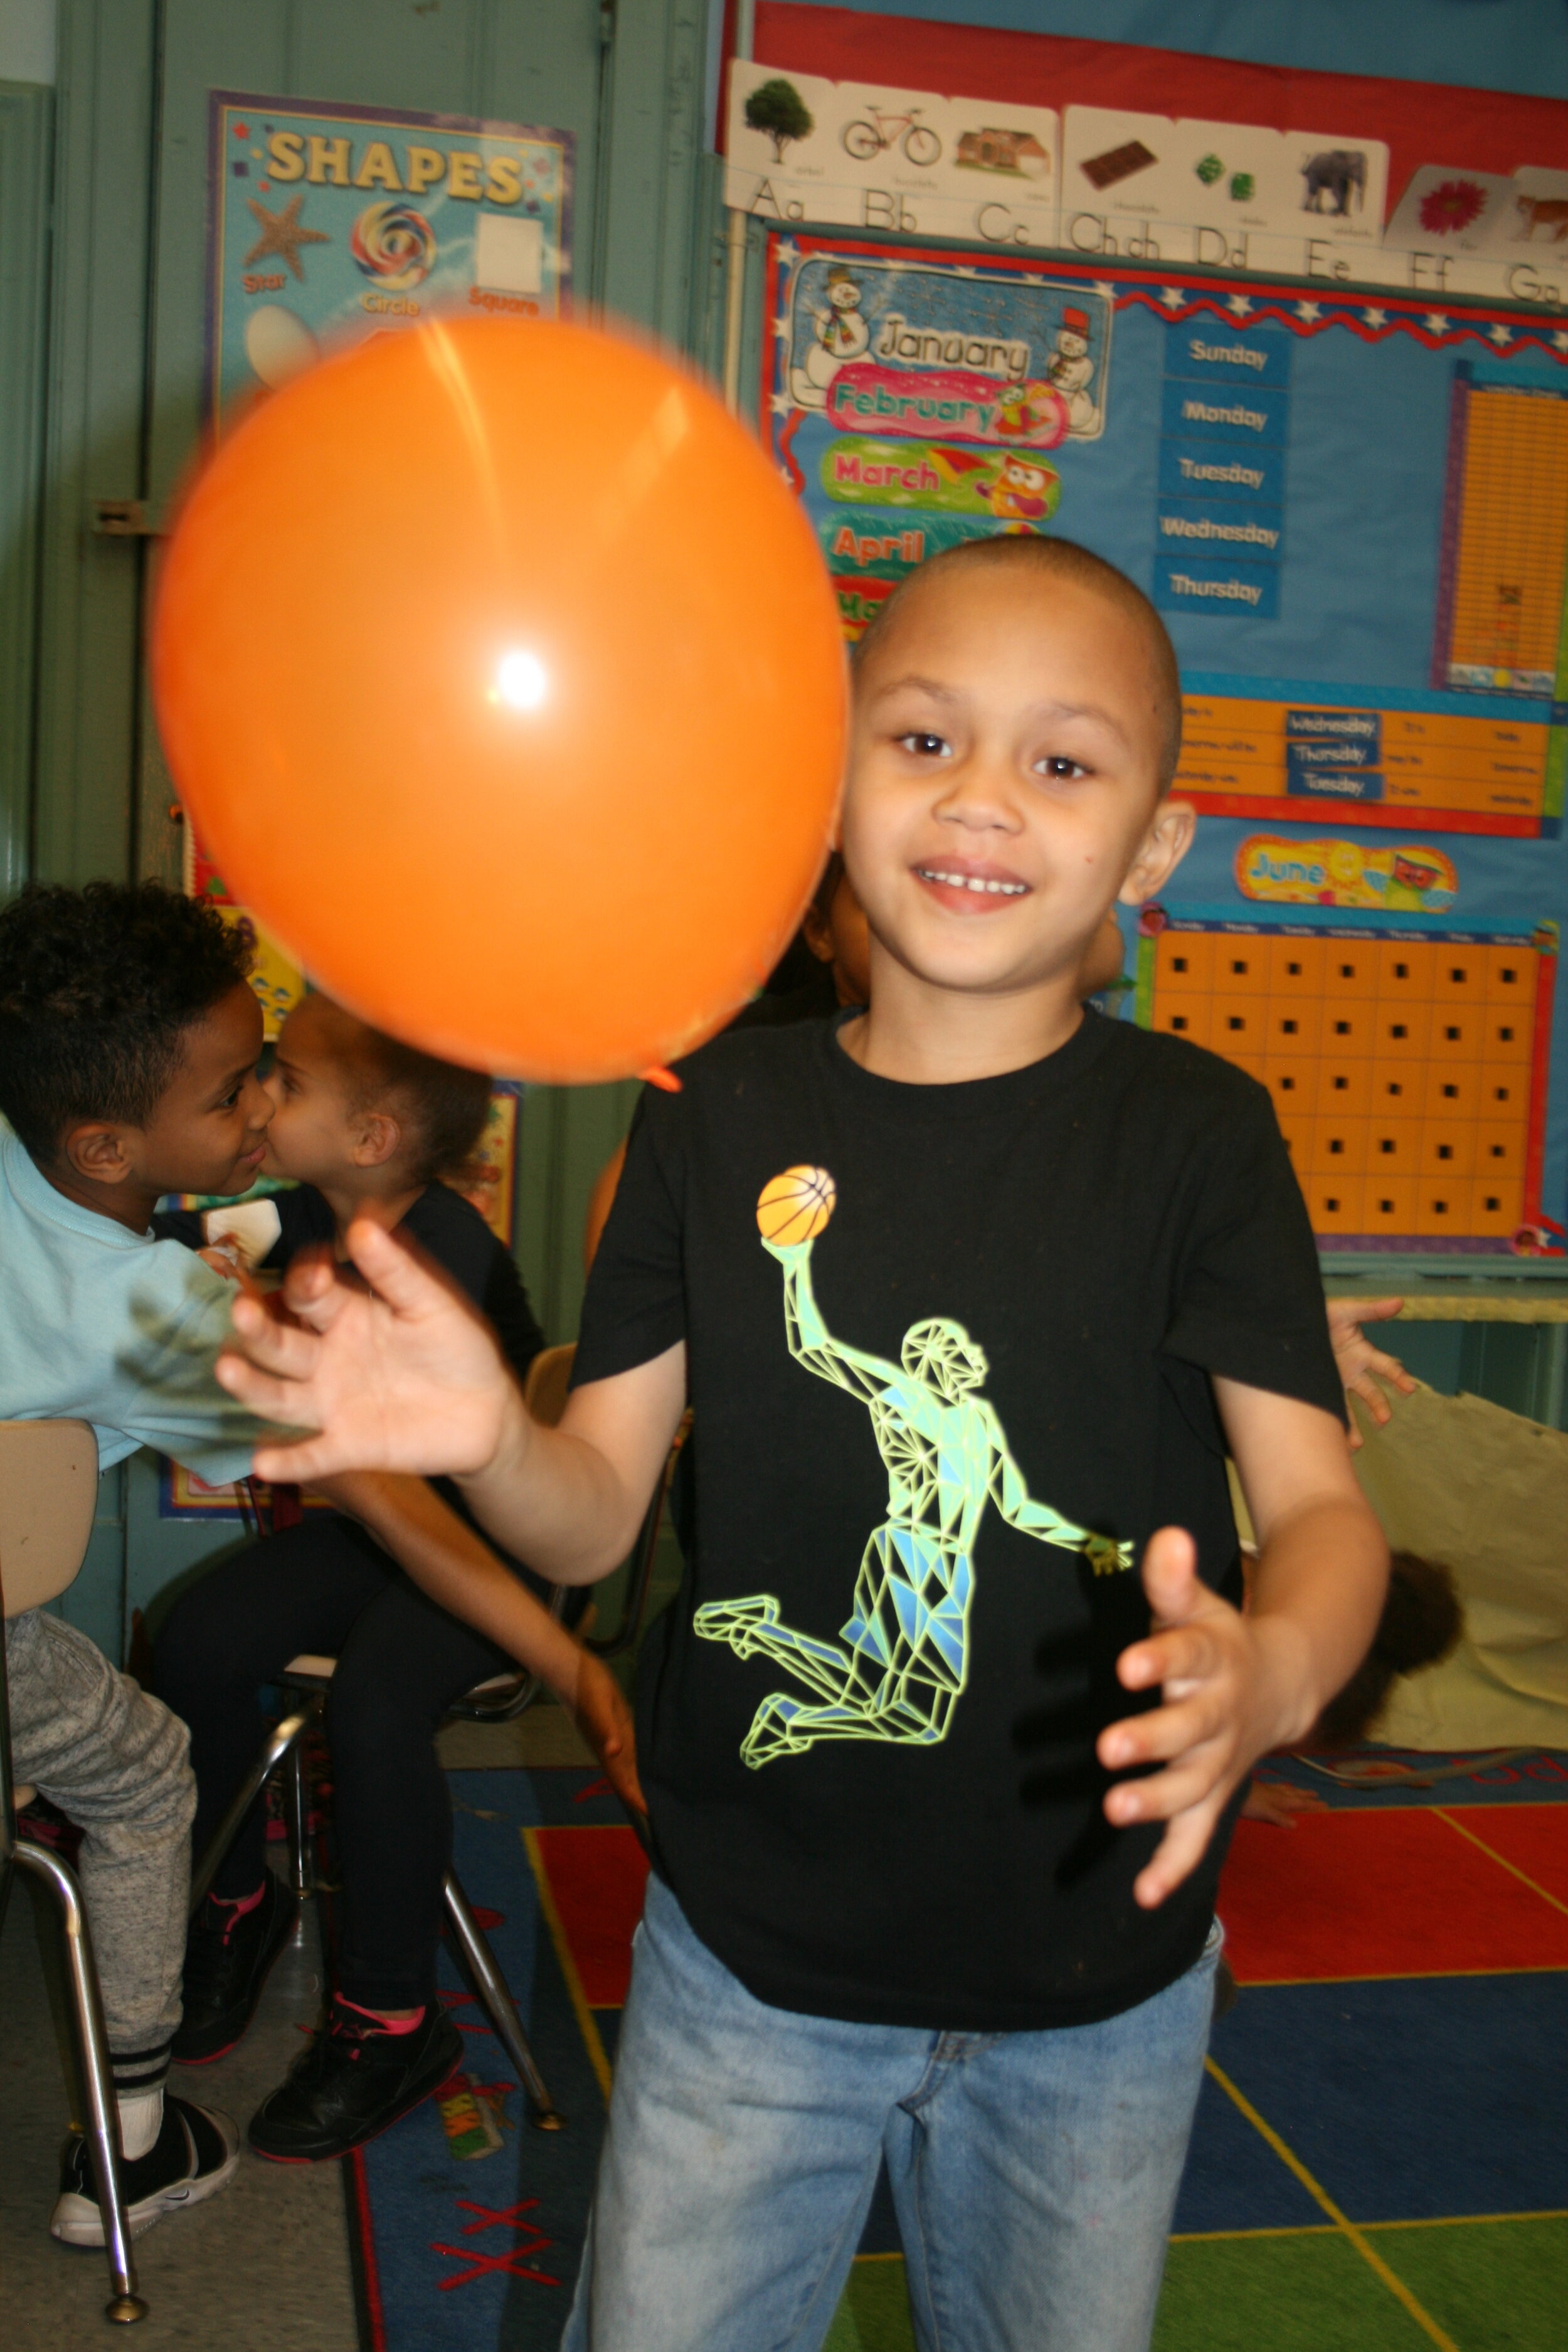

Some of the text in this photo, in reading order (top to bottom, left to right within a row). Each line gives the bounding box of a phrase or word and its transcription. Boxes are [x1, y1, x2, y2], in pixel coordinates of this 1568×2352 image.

[267, 132, 522, 204] SHAPES
[751, 178, 804, 221] Aa
[863, 189, 917, 232] Bb
[977, 203, 1030, 245] Cc
[1193, 226, 1249, 270] Dd
[1306, 238, 1350, 280] Ee
[1411, 252, 1454, 292] Ff
[242, 273, 285, 294] Star
[361, 292, 420, 317] Circle
[469, 286, 539, 316] Square
[880, 320, 1027, 381] January
[1189, 339, 1268, 372] Sunday
[835, 383, 996, 434] February
[1182, 400, 1268, 432] Monday
[834, 453, 940, 490] March
[1178, 457, 1264, 490] Tuesday
[834, 527, 924, 566] April
[1159, 516, 1279, 550] Wednesday
[837, 591, 882, 621] Ma
[1168, 573, 1263, 607] Thursday
[1290, 714, 1376, 738] Wednesday
[1293, 743, 1367, 765] Thursday
[1303, 771, 1365, 797] Tuesday
[1250, 852, 1326, 887] June
